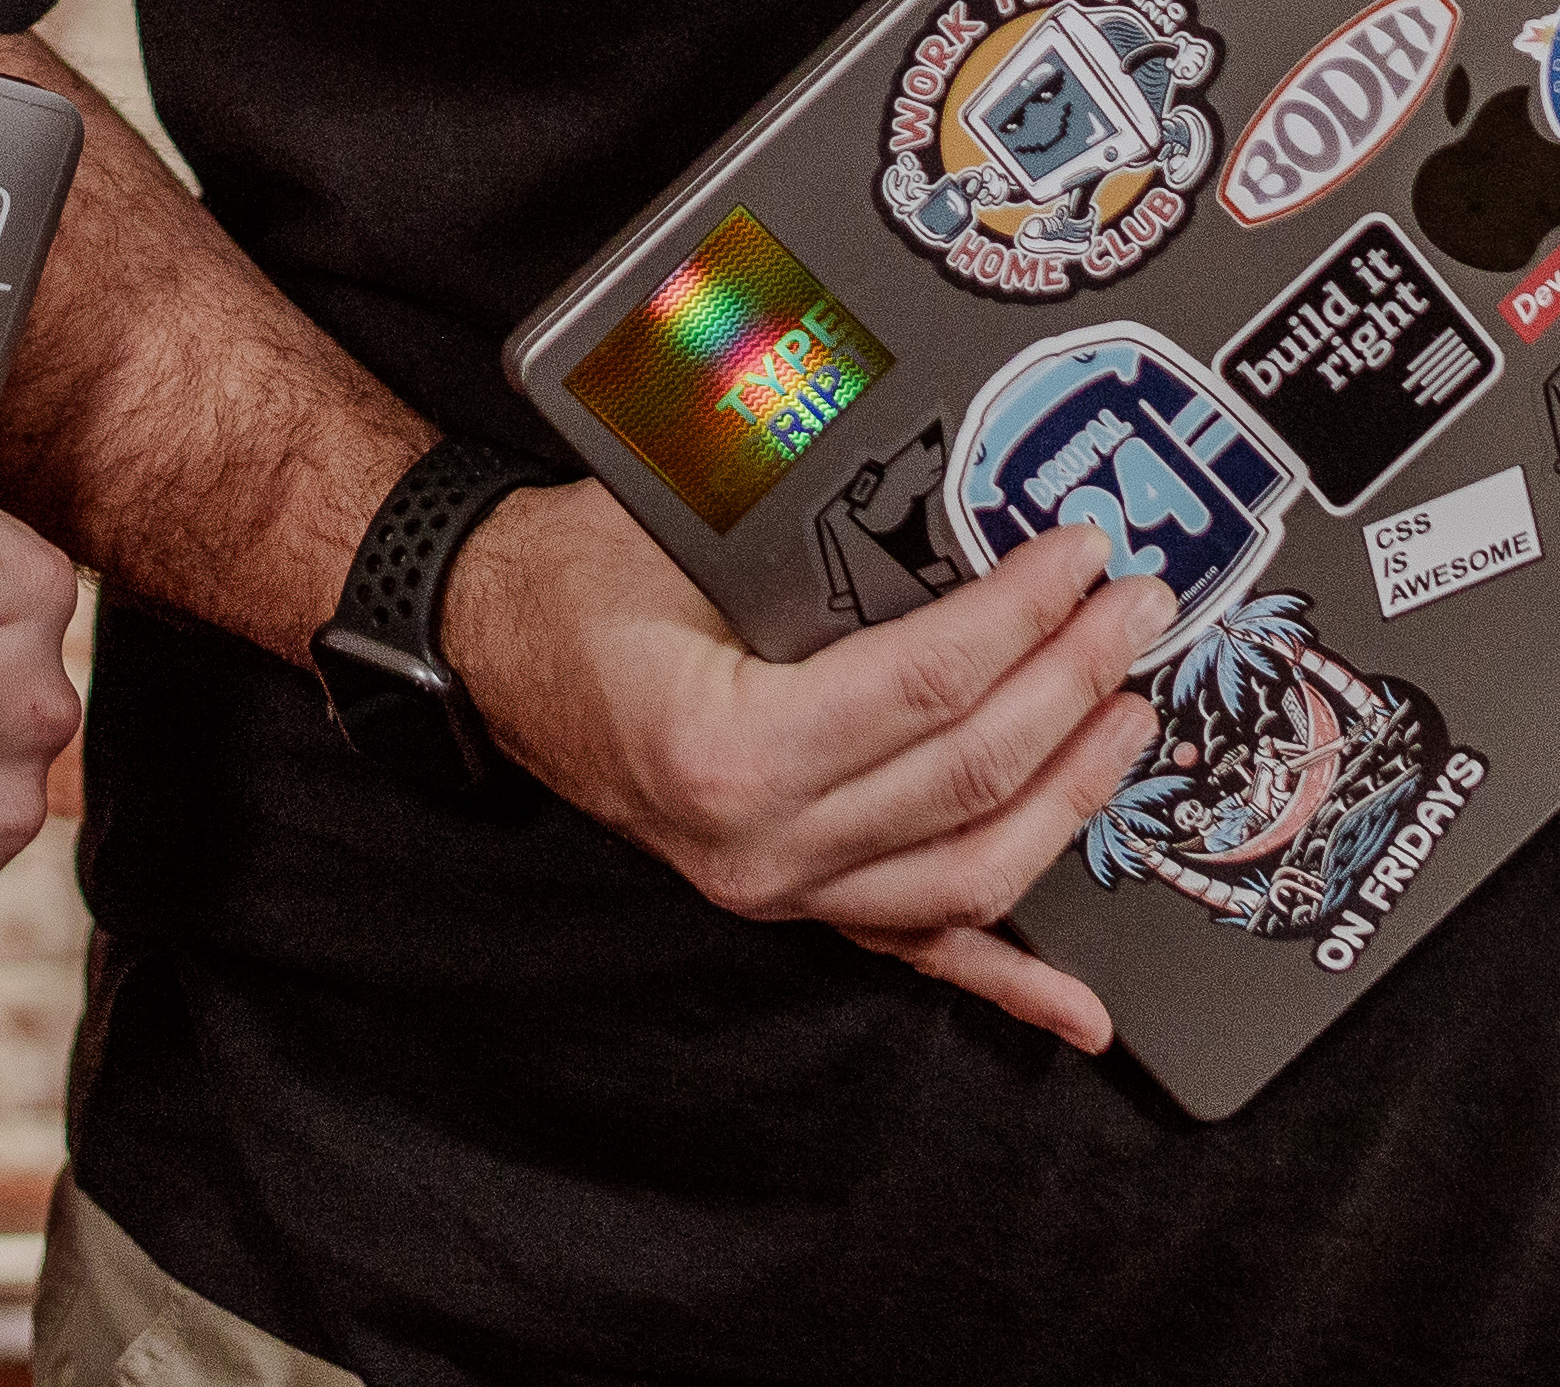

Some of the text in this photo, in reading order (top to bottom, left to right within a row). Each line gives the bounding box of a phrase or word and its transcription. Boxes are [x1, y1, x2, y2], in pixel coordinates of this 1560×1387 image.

[890, 0, 987, 152] WORK
[1238, 5, 1436, 205] BODHI
[947, 188, 1185, 291] HOME CLUB
[715, 301, 845, 425] TYPE
[1236, 247, 1403, 398] build it
[1315, 279, 1431, 393] right
[1023, 408, 1136, 513] DRUPAL
[1057, 437, 1213, 581] 24
[1375, 512, 1432, 550] CSS
[1383, 551, 1408, 578] IS
[1389, 530, 1533, 606] AWESOME
[1316, 752, 1484, 972] ON FRIDAYS
